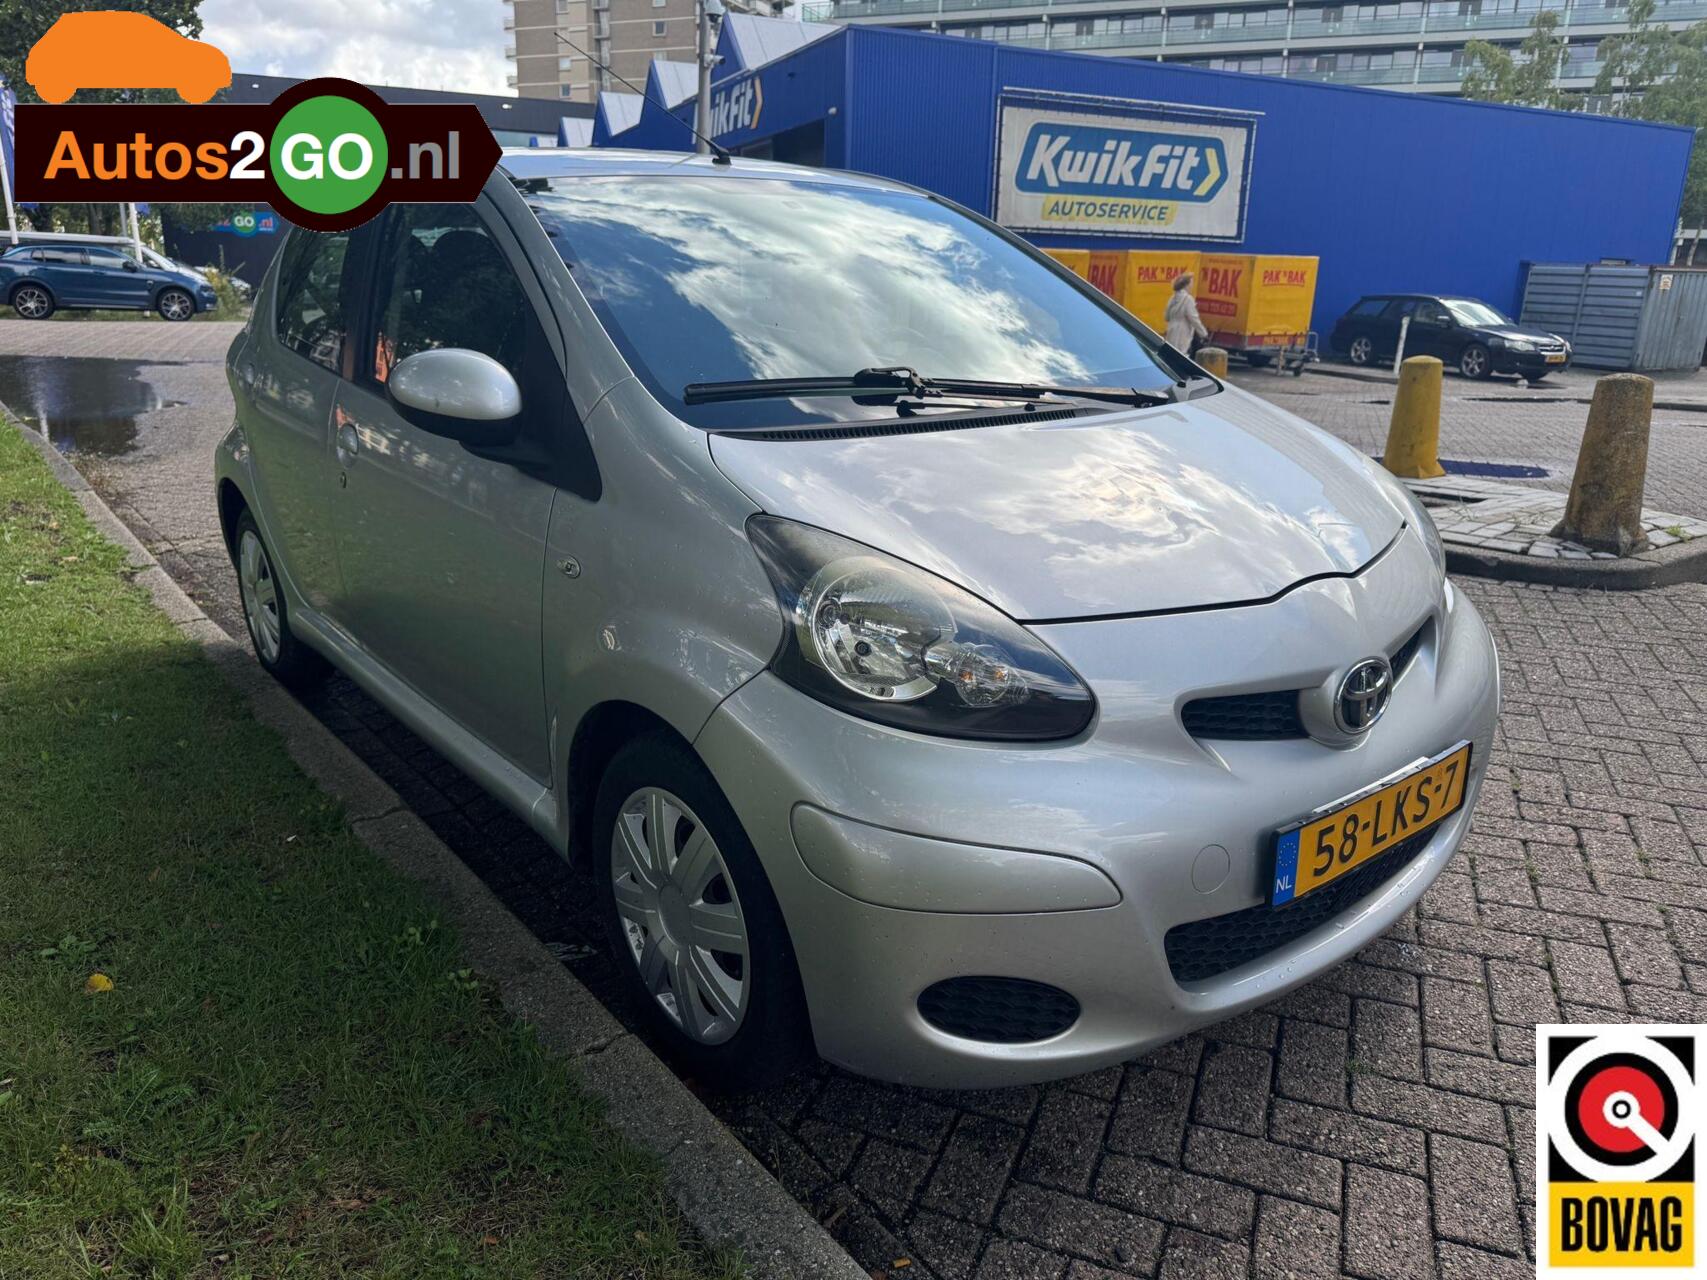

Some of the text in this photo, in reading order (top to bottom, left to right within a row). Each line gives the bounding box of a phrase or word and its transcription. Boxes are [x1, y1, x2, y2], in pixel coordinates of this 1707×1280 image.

[1048, 200, 1169, 221] AUTOSERVICE
[1137, 266, 1157, 280] PAK
[1263, 269, 1281, 283] PAK
[1287, 270, 1307, 284] BAK
[1208, 268, 1242, 298] BAK
[1313, 759, 1459, 877] 58-LKS-7
[1275, 875, 1292, 893] NL
